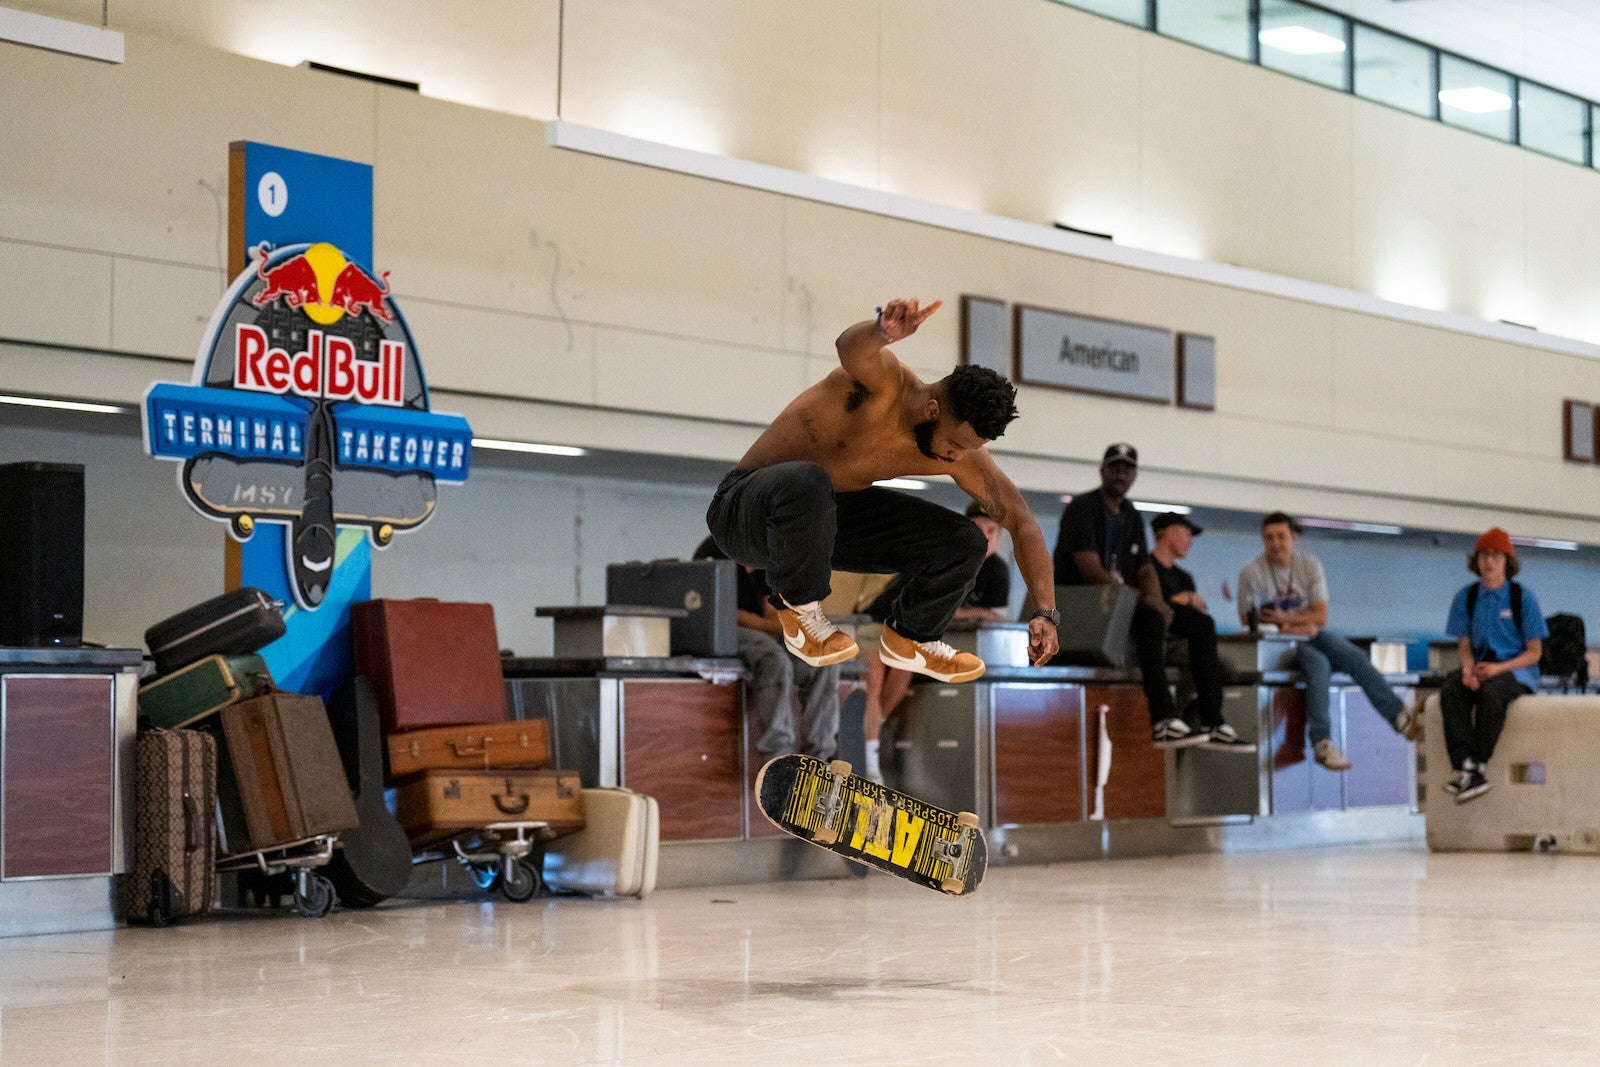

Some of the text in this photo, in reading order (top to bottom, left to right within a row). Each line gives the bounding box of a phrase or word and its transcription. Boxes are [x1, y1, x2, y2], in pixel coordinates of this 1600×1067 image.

[268, 184, 275, 205] 1
[235, 325, 404, 405] Red Bull
[1059, 335, 1140, 373] American
[163, 413, 464, 468] TERMINAL TAKEOVER
[850, 792, 925, 869] ATL
